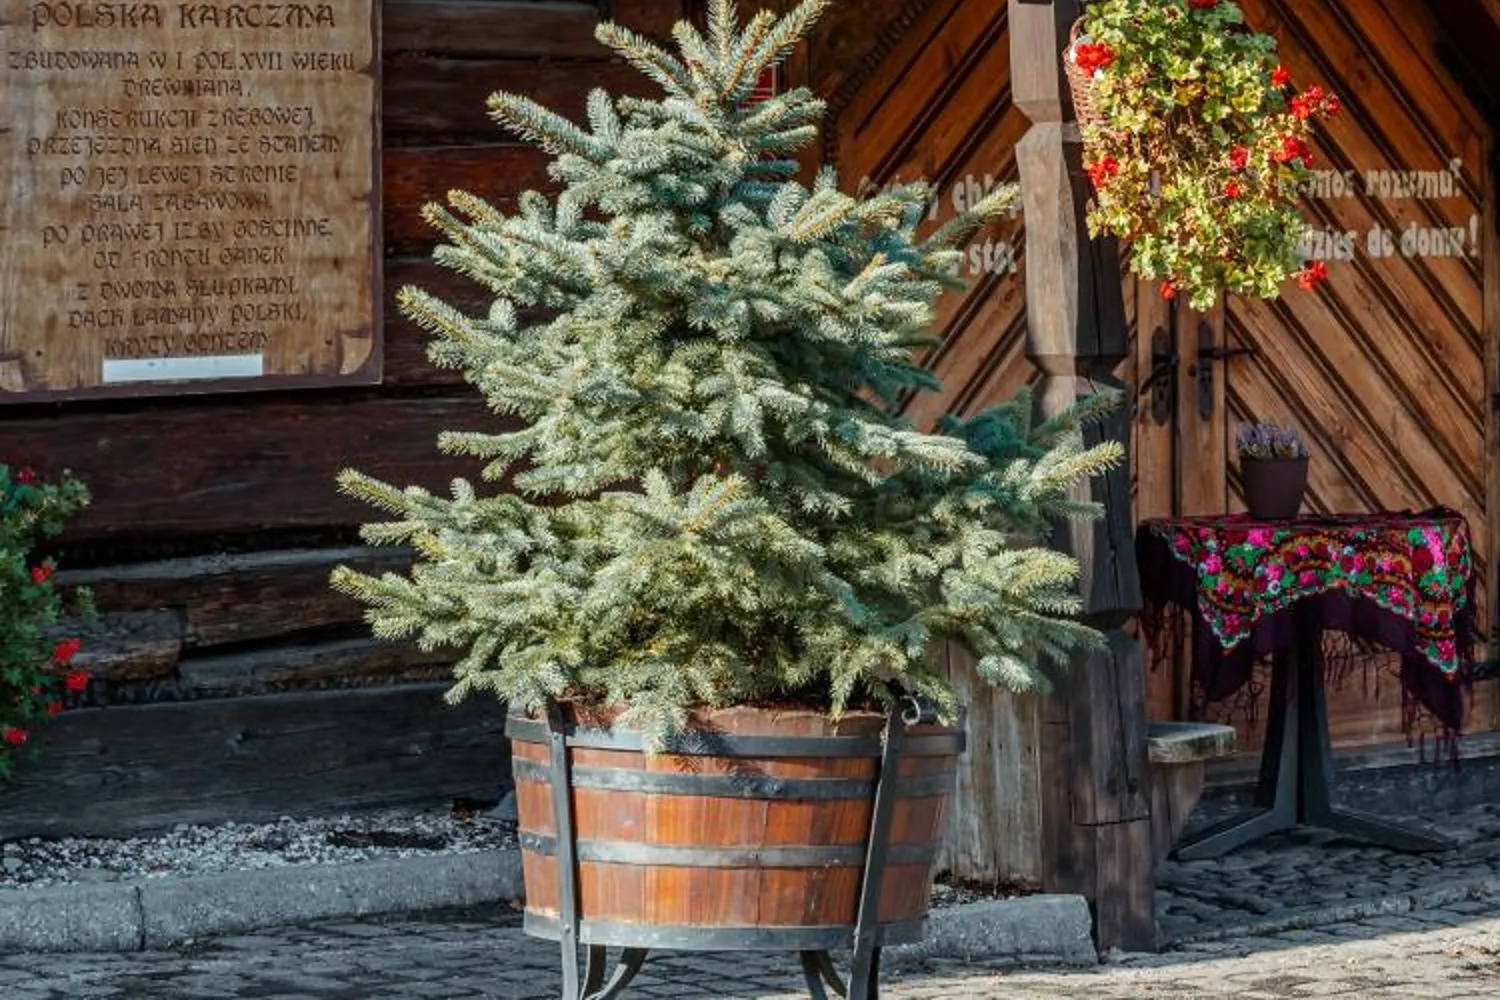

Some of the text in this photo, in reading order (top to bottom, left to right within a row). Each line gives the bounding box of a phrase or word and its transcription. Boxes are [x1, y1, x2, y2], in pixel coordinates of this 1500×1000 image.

[31, 1, 336, 33] POLSKA KARCZMA
[8, 50, 140, 71] ZBUDOWANA
[149, 50, 167, 70] W
[176, 51, 183, 70] I
[291, 49, 355, 71] WIEKU
[55, 107, 198, 130] KONSTRUKCJI
[27, 134, 162, 160] PRZEJEZDNA
[226, 134, 250, 154] ZE
[60, 163, 299, 190] PO JEJ LEWEJ STRONIE
[91, 192, 144, 213] SALA
[42, 224, 70, 249] PO
[80, 222, 164, 246] PRAWEJ
[174, 219, 226, 243] IZBY
[1367, 222, 1396, 258] do
[131, 248, 211, 269] FRONTU
[218, 245, 286, 266] GANEK
[76, 283, 90, 301] Z
[100, 279, 177, 300] DWOMA
[67, 308, 125, 329] DACH
